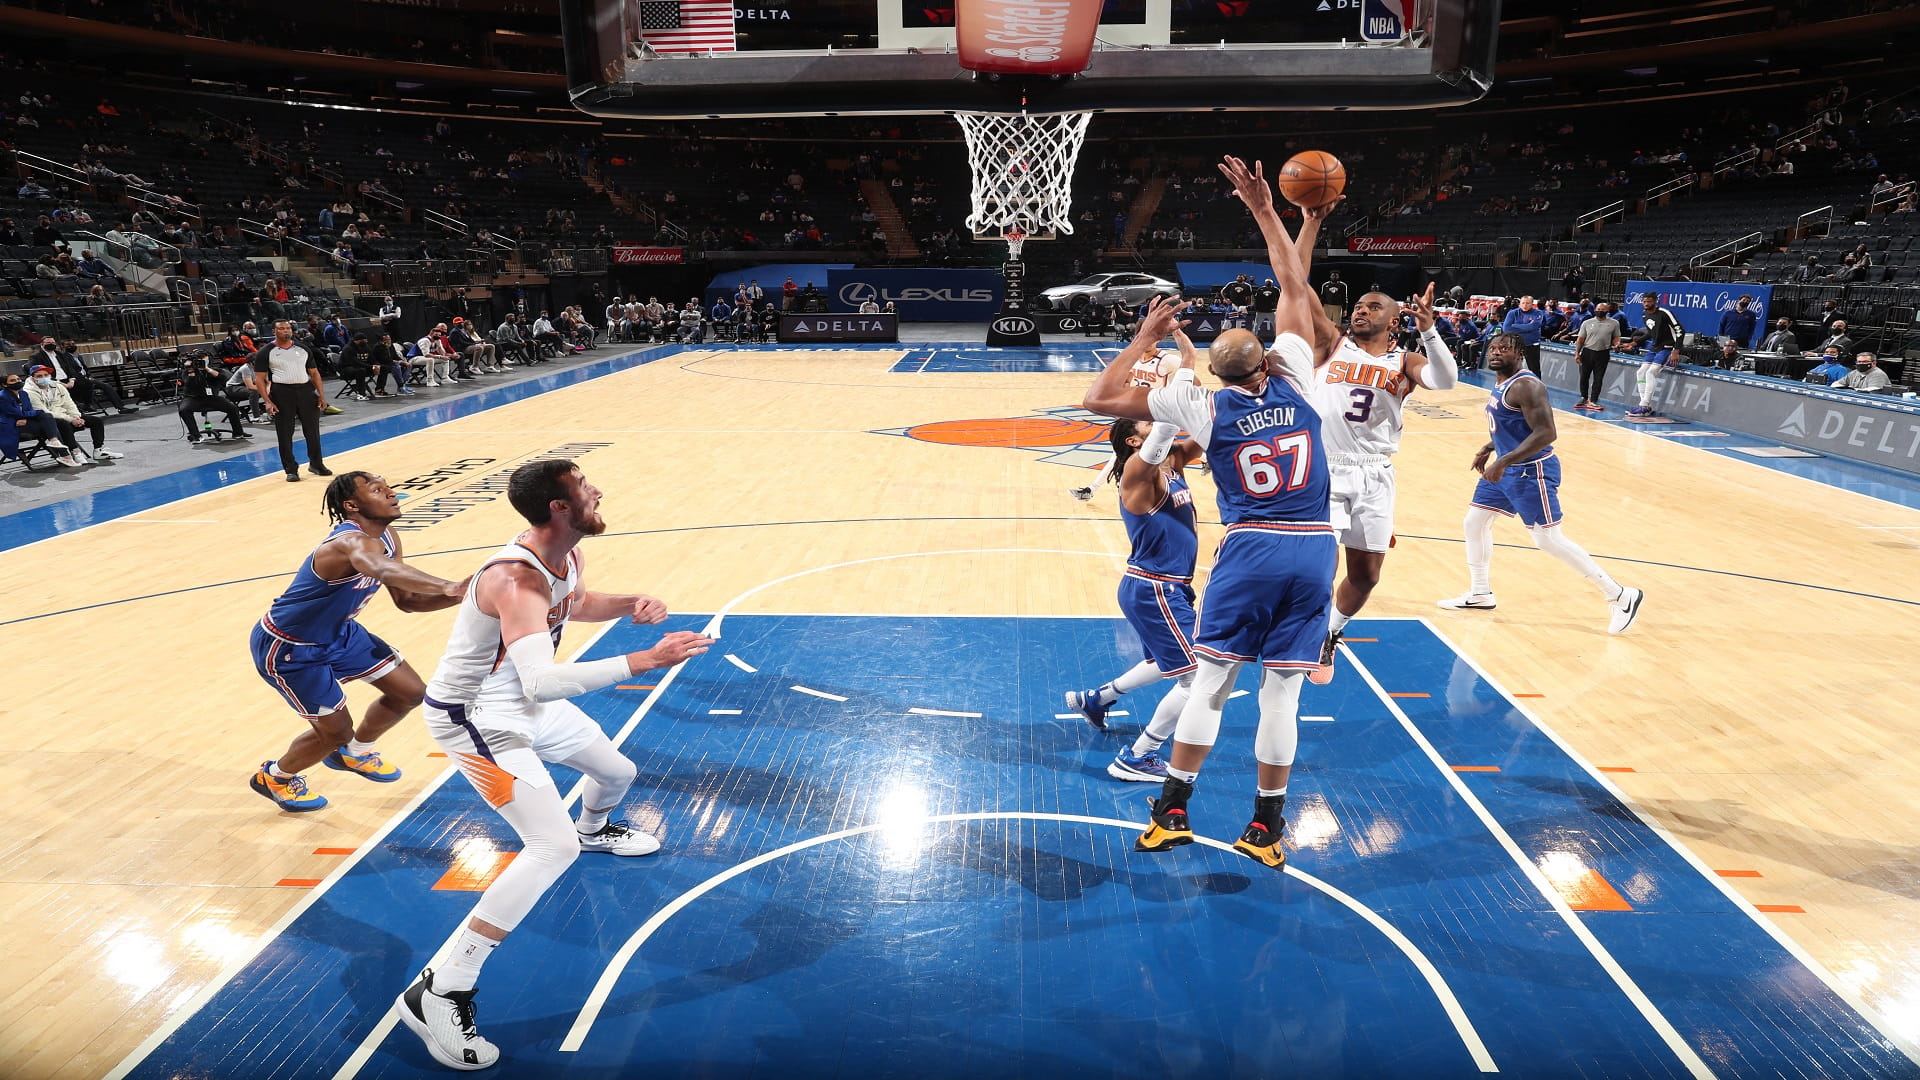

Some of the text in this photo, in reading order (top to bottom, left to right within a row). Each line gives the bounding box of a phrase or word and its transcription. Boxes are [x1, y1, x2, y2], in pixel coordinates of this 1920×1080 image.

[734, 9, 791, 20] DELTA
[1369, 17, 1395, 35] NBA
[615, 249, 681, 263] Budweiser
[882, 287, 993, 302] LEXUS
[1668, 293, 1708, 310] ULTRA
[817, 320, 884, 332] DELTA
[1000, 320, 1028, 332] KIA
[1345, 387, 1375, 423] 3
[1236, 407, 1296, 437] GIBSON
[1234, 430, 1313, 498] 67
[390, 457, 497, 492] CHASE
